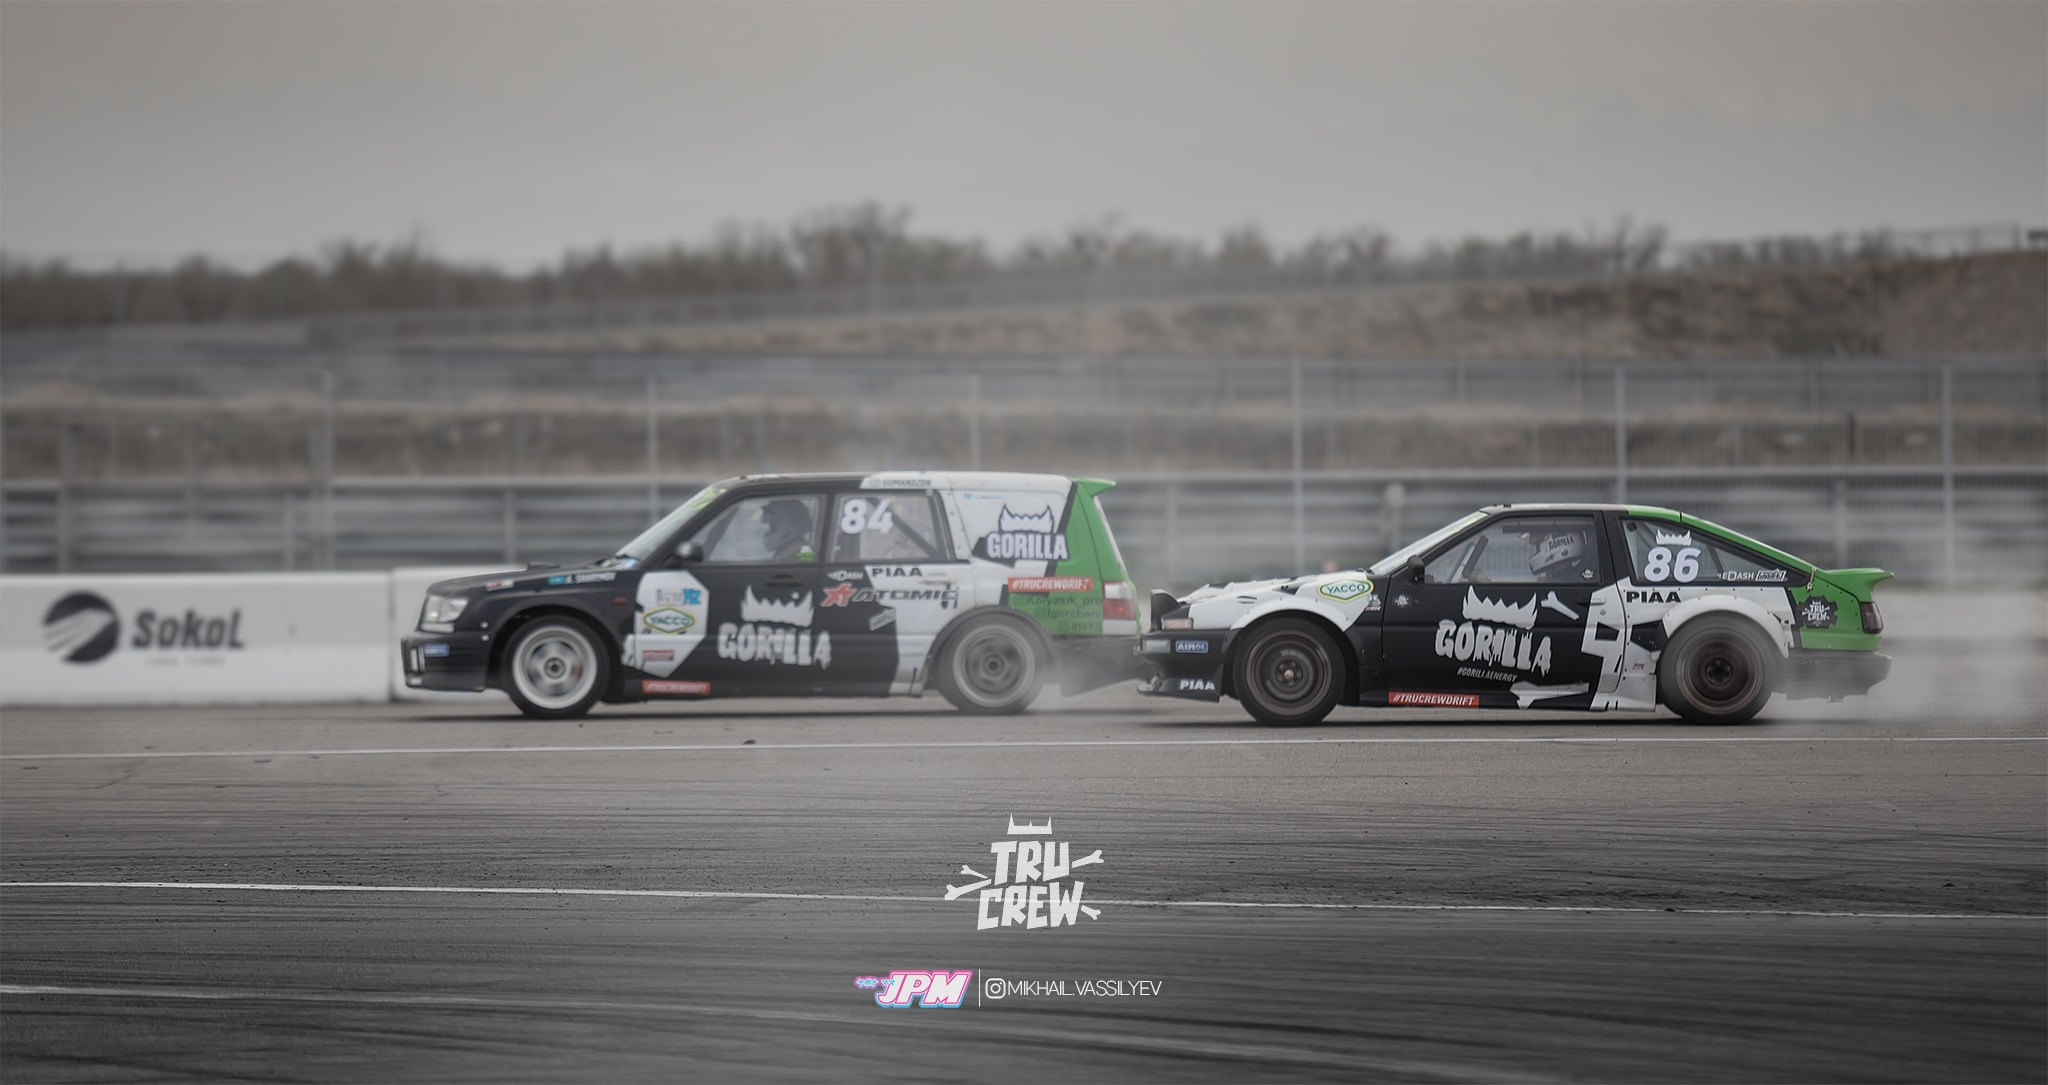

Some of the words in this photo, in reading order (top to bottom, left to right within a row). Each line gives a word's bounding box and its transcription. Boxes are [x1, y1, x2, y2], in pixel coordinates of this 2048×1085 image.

[841, 498, 893, 535] 84
[986, 532, 1068, 560] GORILLA
[872, 567, 923, 577] PIAA
[1644, 546, 1702, 583] 86
[1326, 584, 1366, 594] YACCO
[1626, 591, 1681, 603] PIAA
[718, 621, 832, 671] GORILLA
[1434, 618, 1552, 677] GORILLA
[1179, 678, 1216, 691] PIAA
[1456, 665, 1518, 683] #GORILLAENERGY
